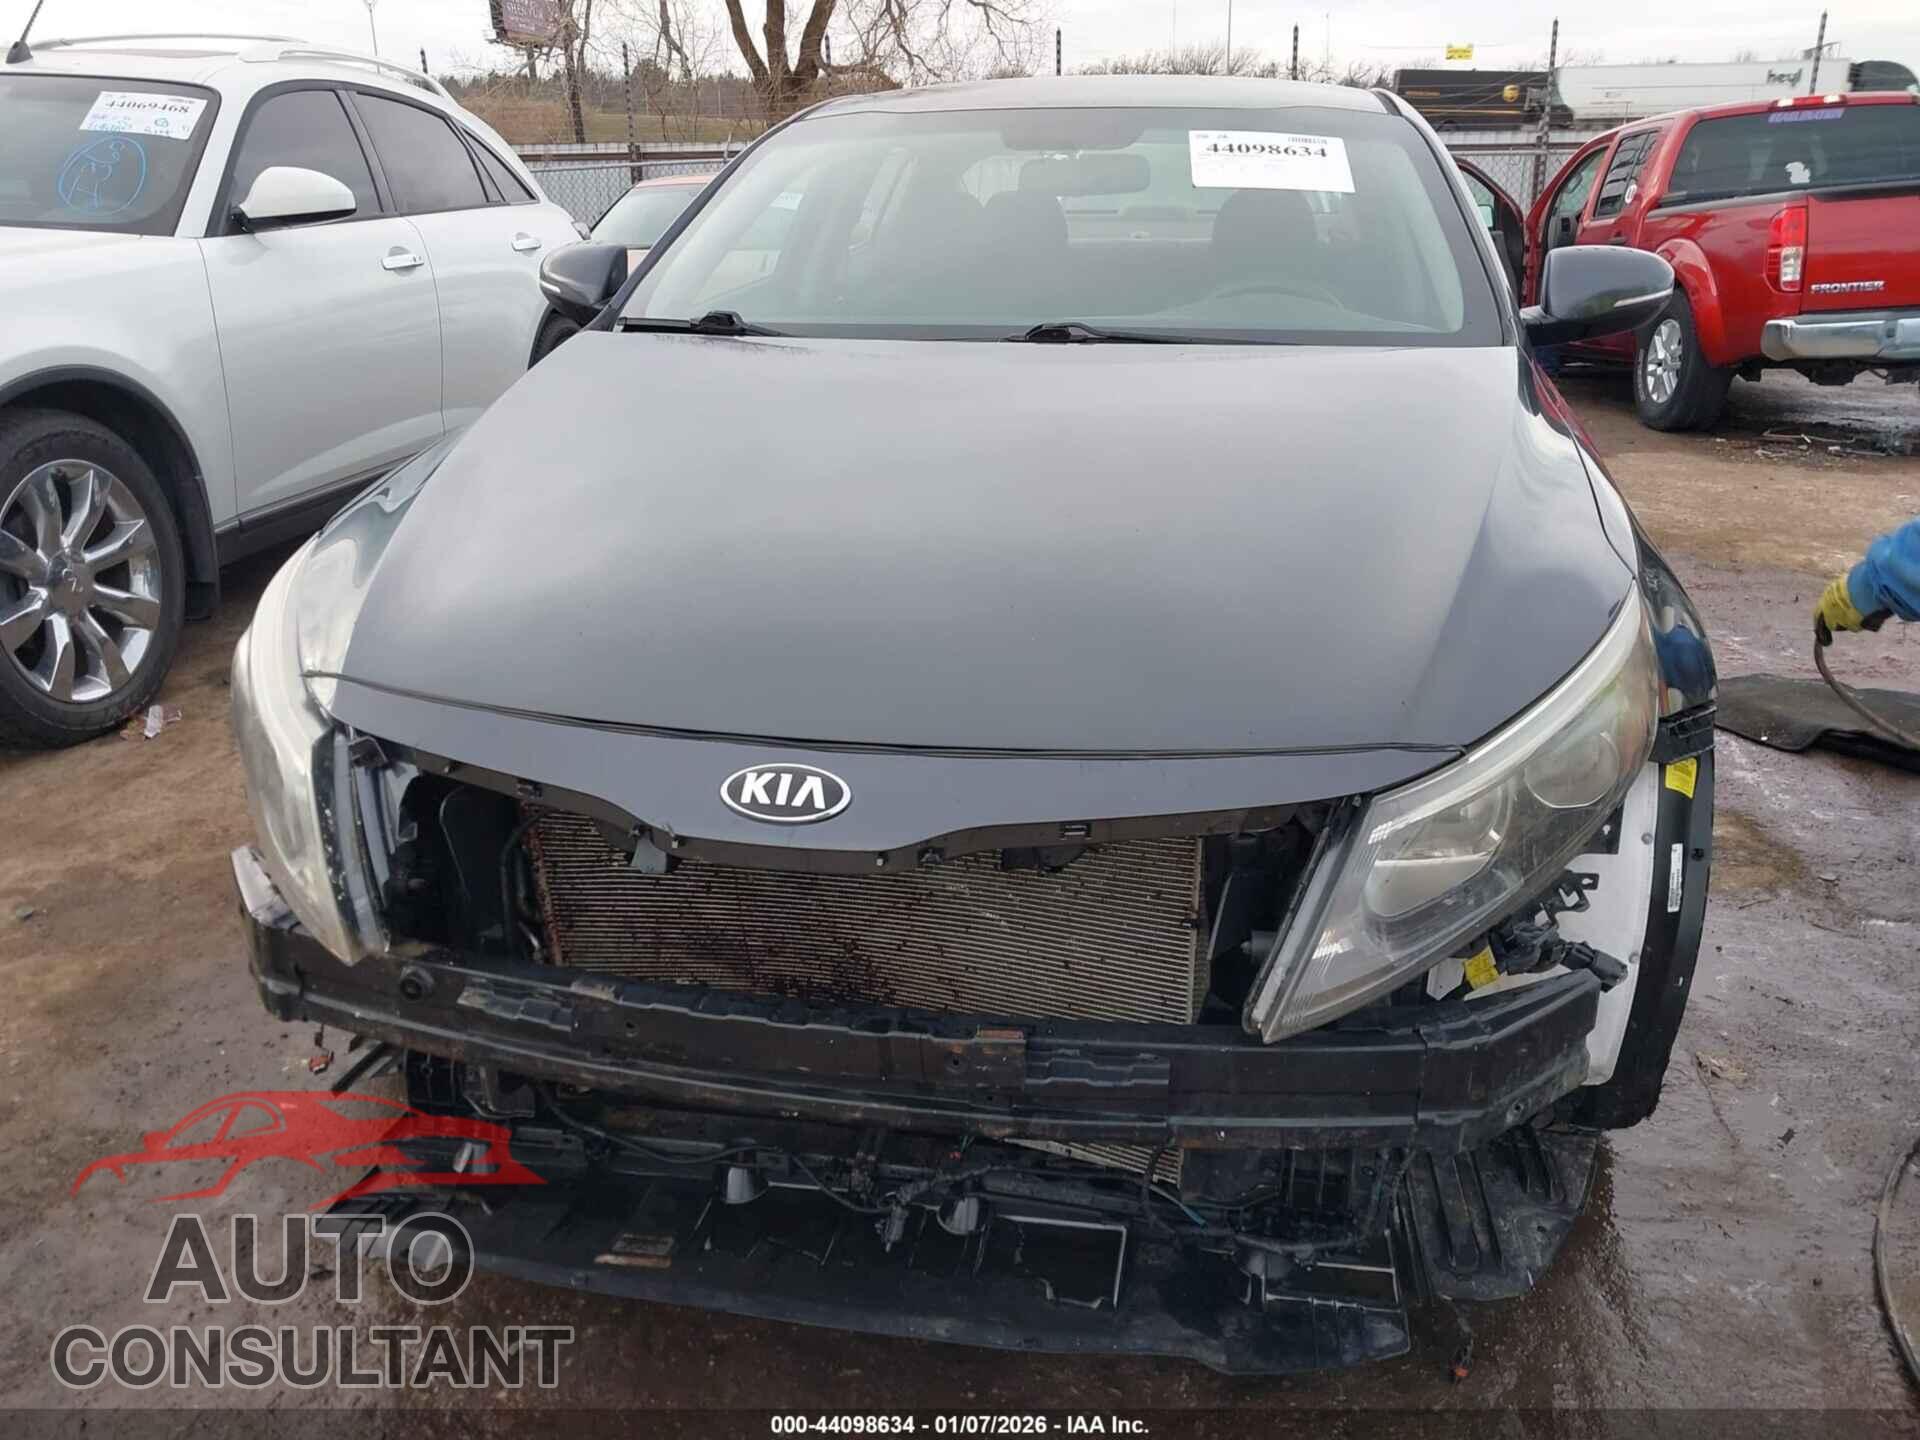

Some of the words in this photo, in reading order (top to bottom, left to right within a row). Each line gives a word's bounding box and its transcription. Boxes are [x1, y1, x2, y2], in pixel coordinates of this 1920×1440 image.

[1206, 143, 1328, 157] 44098634
[1811, 281, 1885, 294] FRONTIER
[740, 772, 826, 809] KIA
